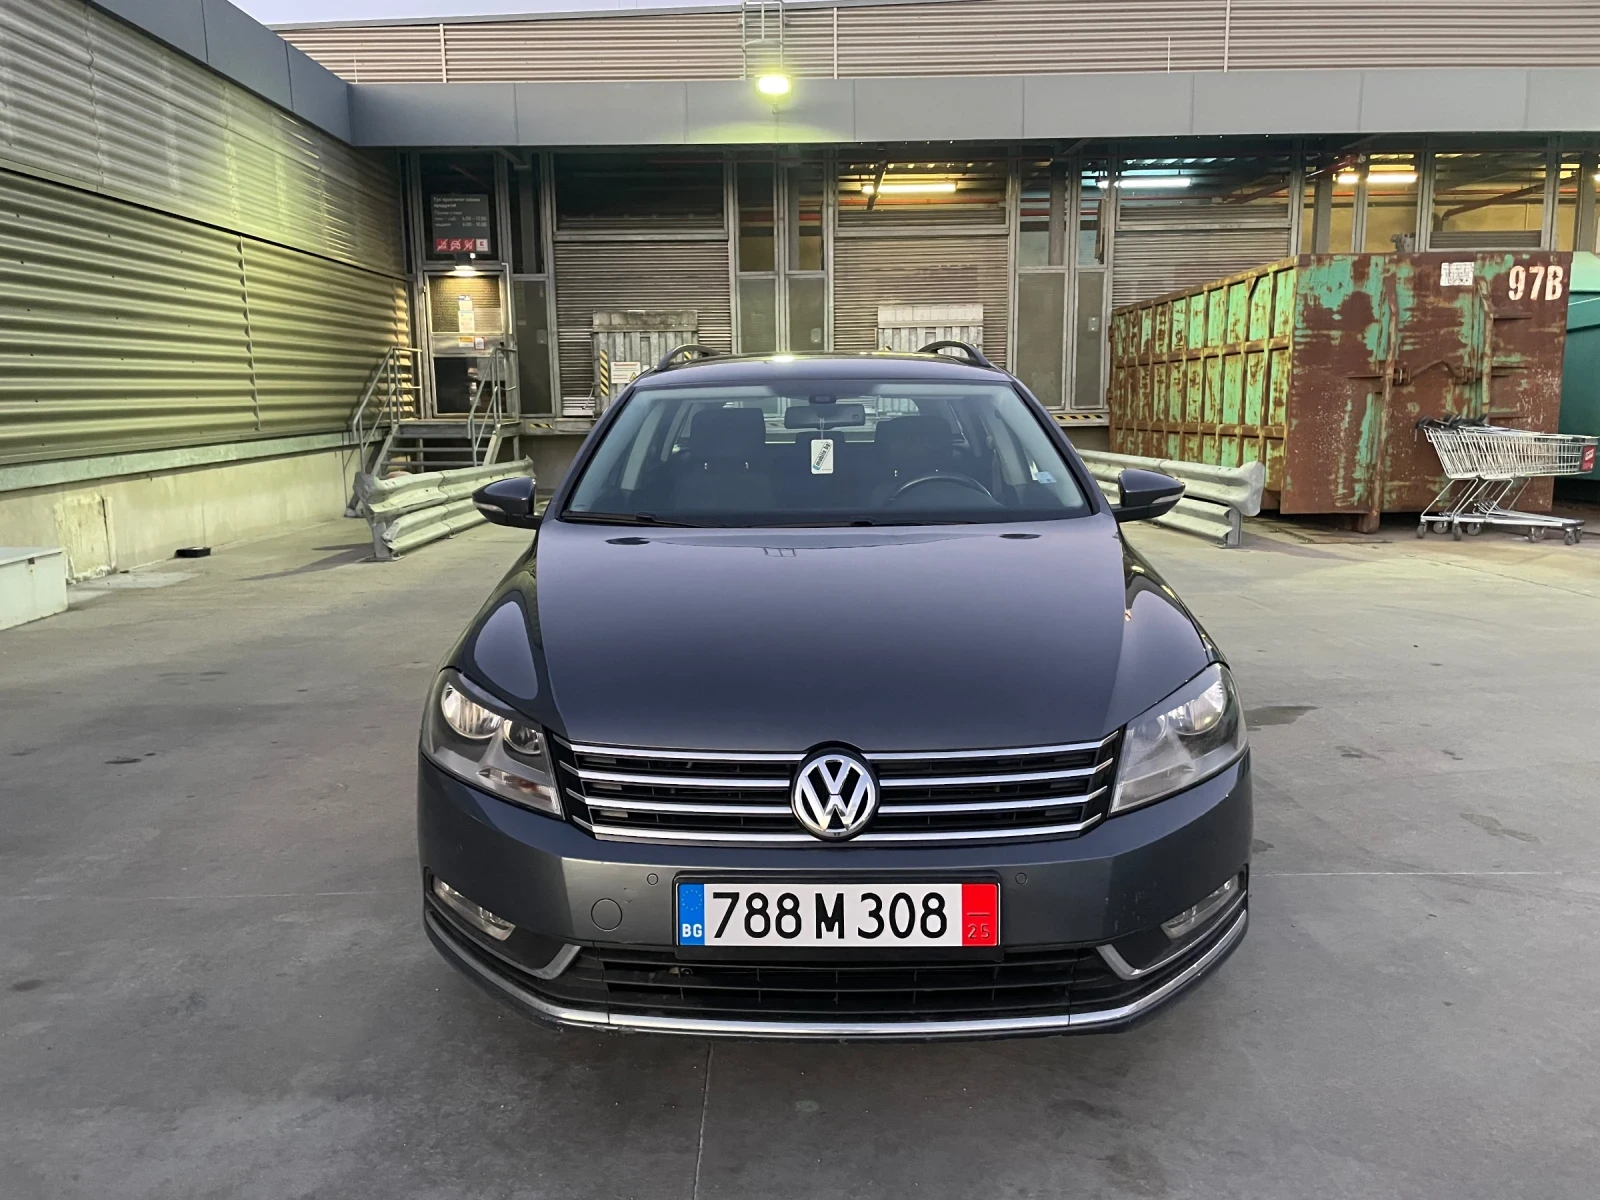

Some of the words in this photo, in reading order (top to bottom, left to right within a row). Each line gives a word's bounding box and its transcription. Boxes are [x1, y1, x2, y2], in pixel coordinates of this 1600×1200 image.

[1508, 265, 1564, 301] 97B
[682, 923, 702, 938] BG
[712, 892, 801, 939] 788
[815, 892, 845, 939] M
[857, 892, 947, 939] 308
[967, 923, 990, 939] 25
